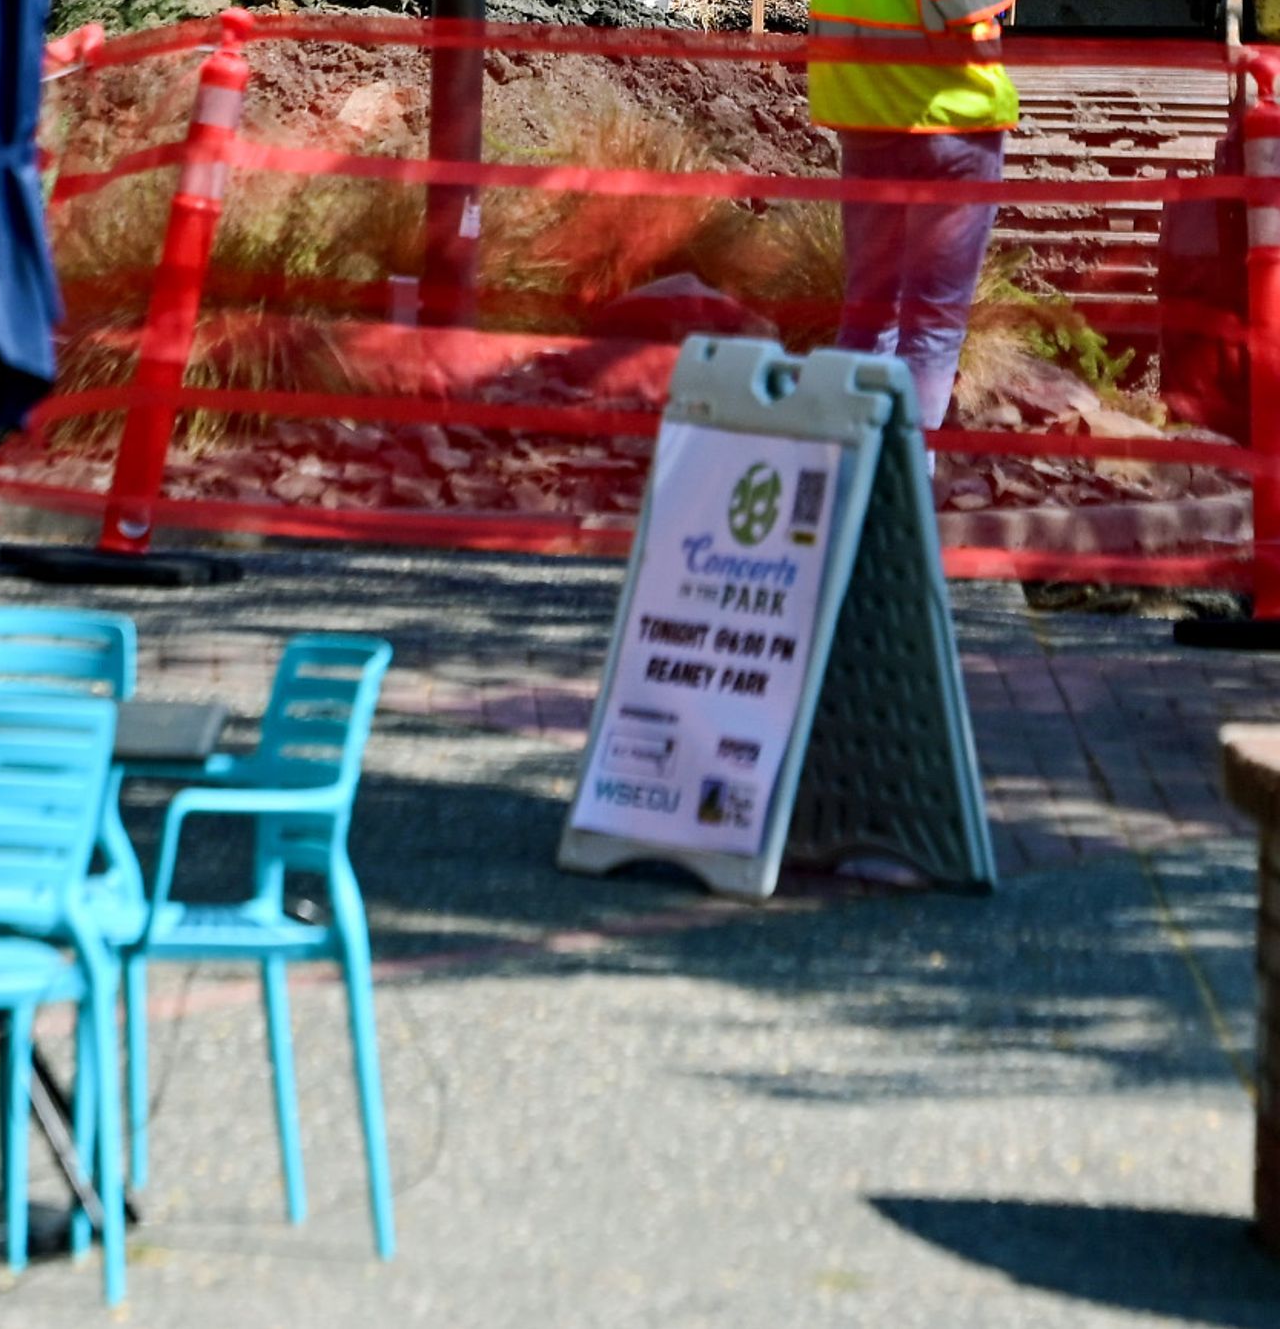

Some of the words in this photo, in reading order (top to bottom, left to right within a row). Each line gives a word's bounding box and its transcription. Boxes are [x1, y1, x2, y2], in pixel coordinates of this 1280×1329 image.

[682, 533, 797, 586] Concerts
[719, 584, 787, 618] PARK
[638, 615, 711, 651] TONIGHT
[768, 635, 797, 663] PM
[719, 666, 770, 697] PARK
